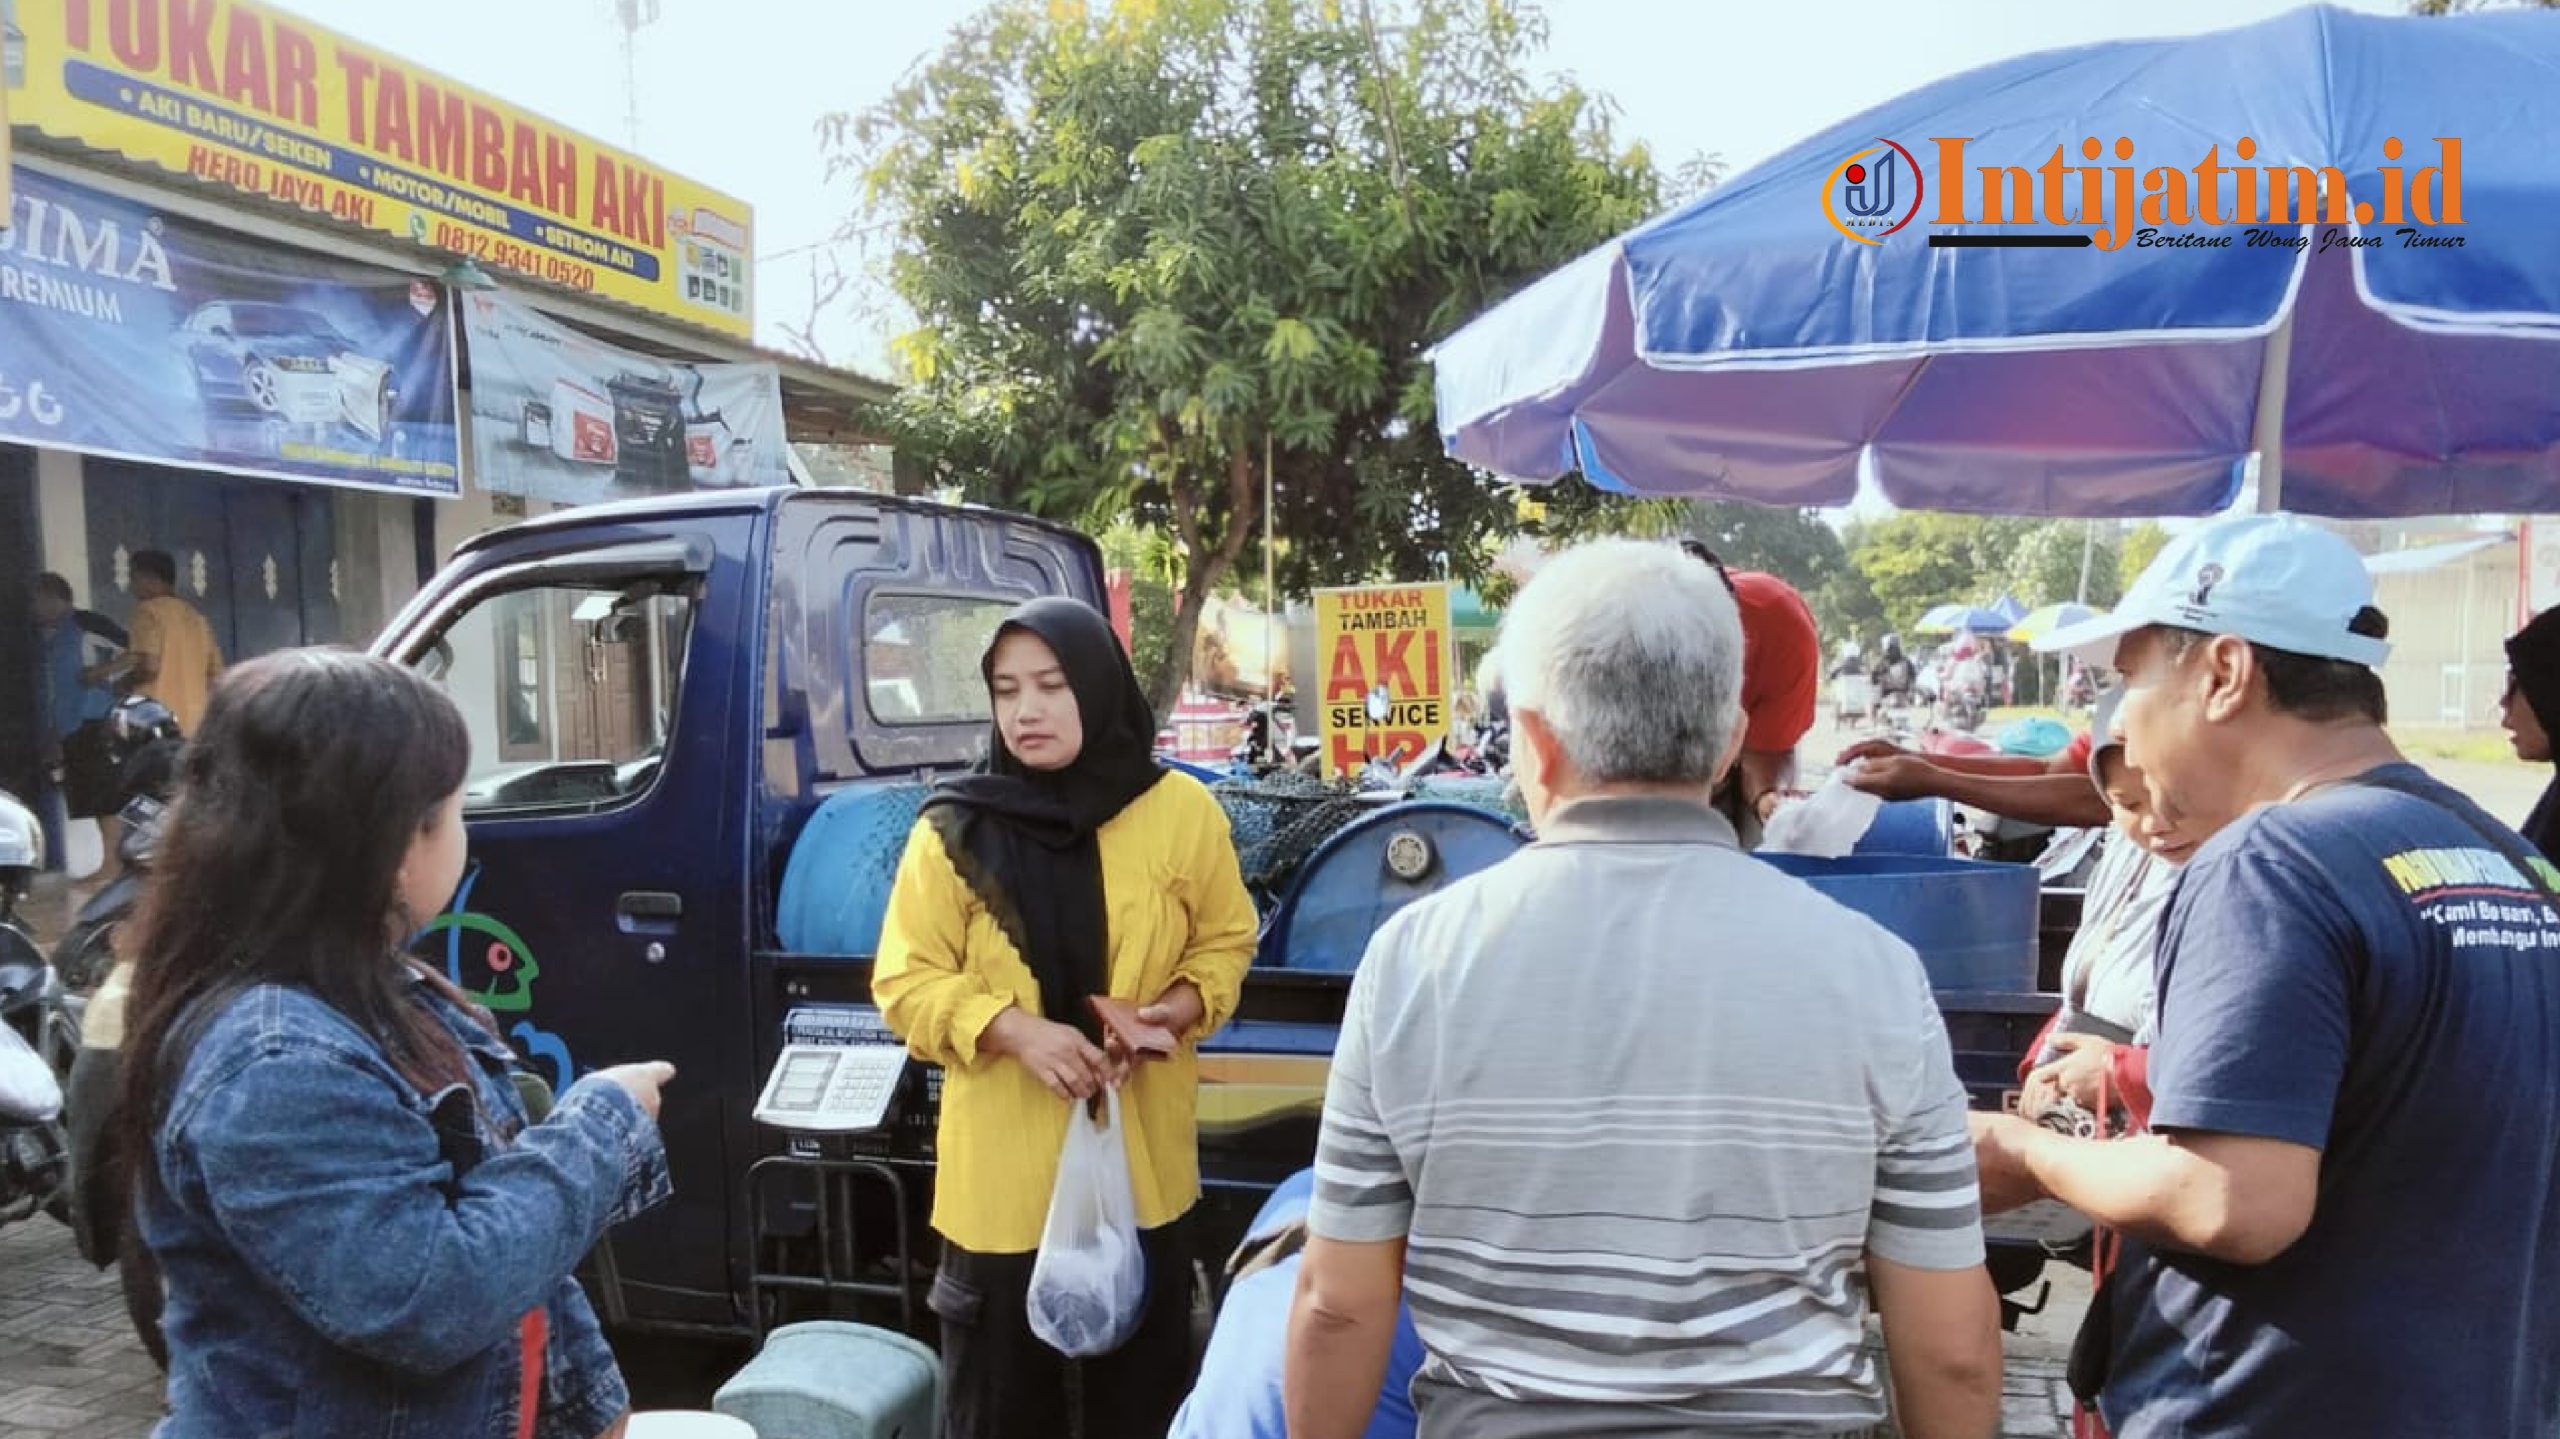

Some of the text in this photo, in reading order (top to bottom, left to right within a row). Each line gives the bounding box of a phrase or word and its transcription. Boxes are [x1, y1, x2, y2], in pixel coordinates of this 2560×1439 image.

[138, 90, 180, 122] AKI
[373, 165, 511, 230] MOTOR/MOBIL
[187, 143, 374, 226] HERO JAYA AKI
[335, 48, 577, 220] TAMBAH
[592, 153, 665, 250] AKI
[436, 221, 595, 291] 0812 9341 0520
[1337, 589, 1423, 610] TUKAR
[1338, 609, 1427, 631] TAMBAH
[1326, 629, 1441, 701] AKI
